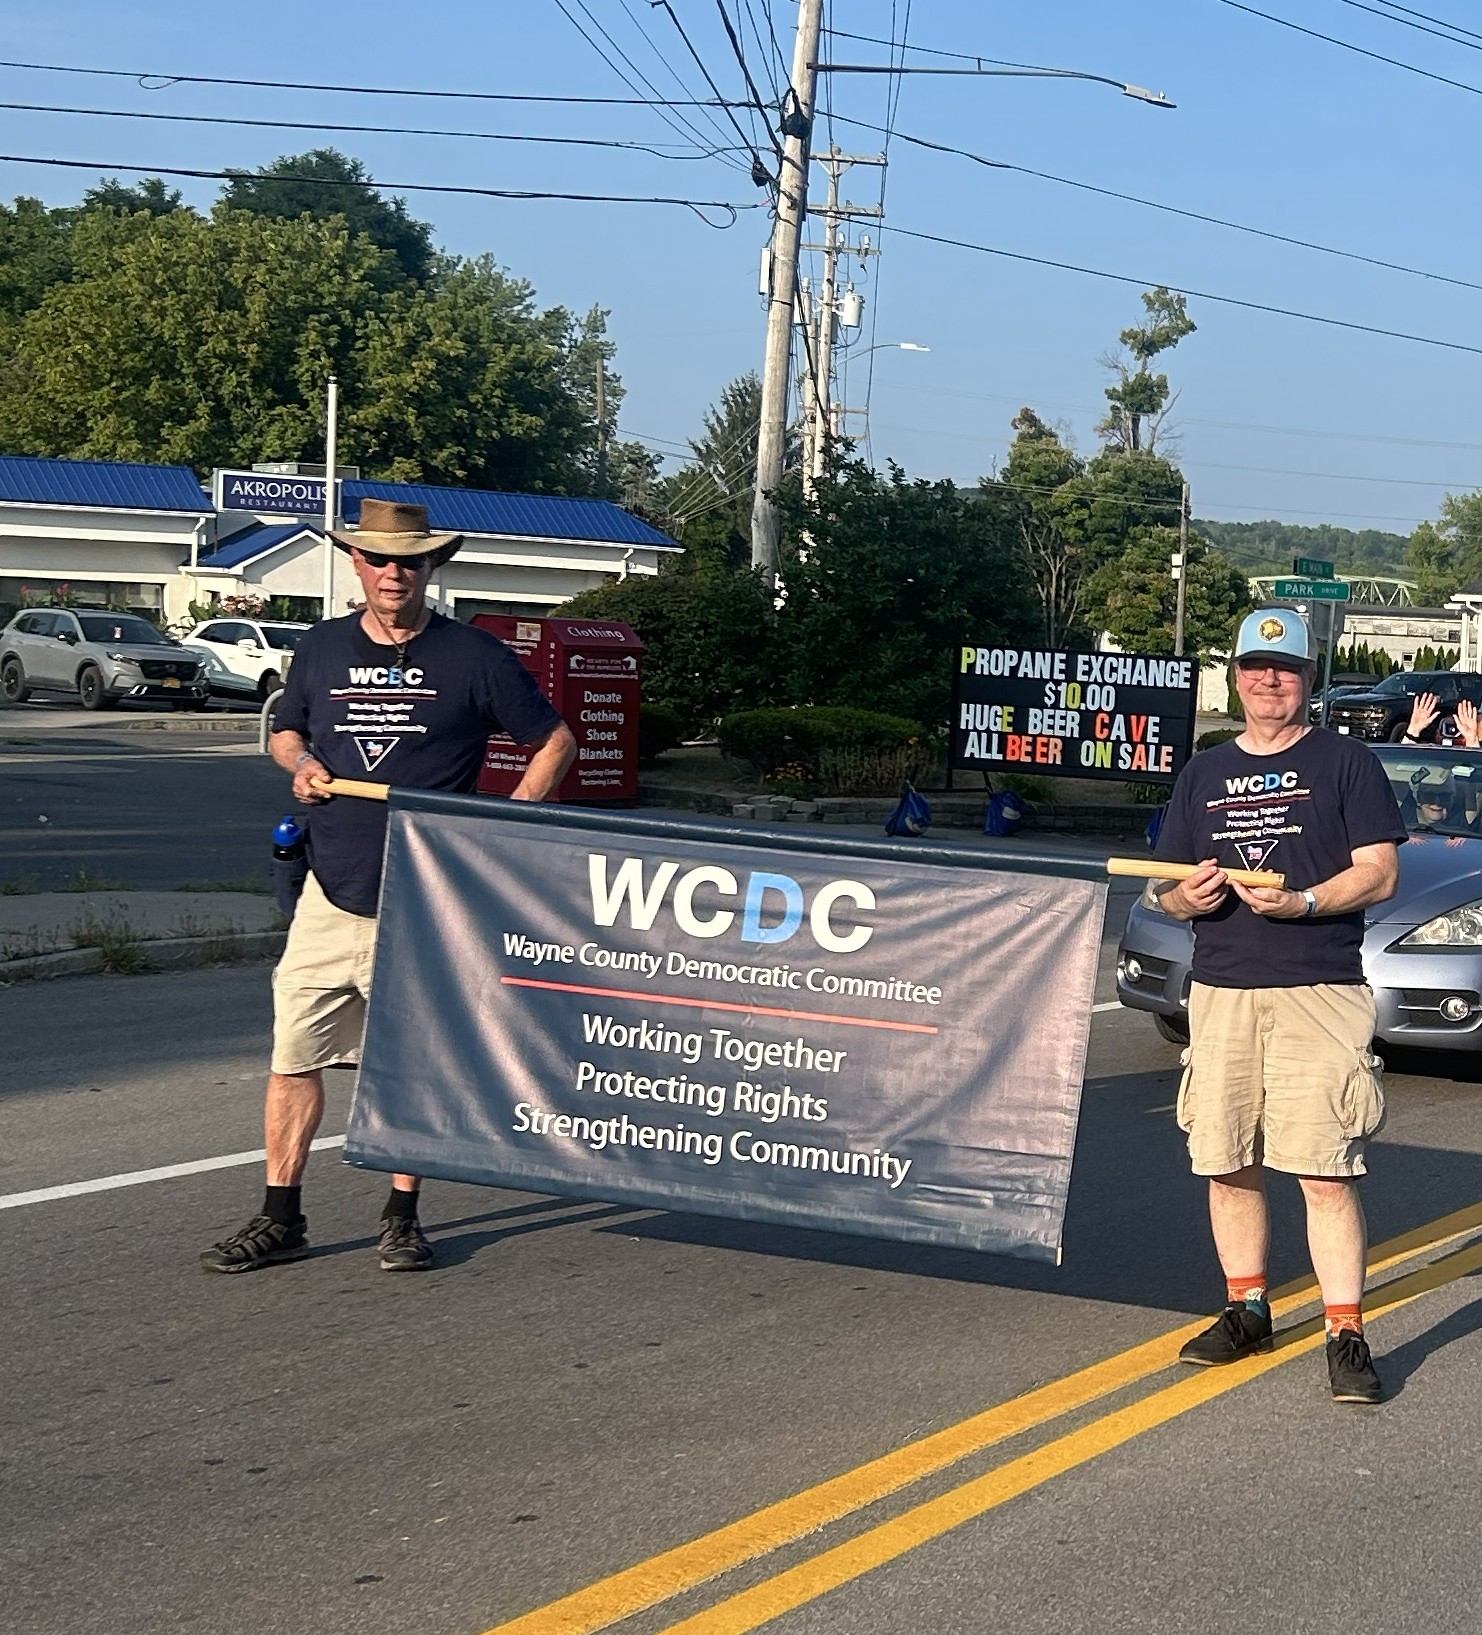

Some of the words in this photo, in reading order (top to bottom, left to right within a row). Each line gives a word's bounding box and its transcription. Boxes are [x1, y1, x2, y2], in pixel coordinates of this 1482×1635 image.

[240, 498, 318, 509] RESTAURANT
[1284, 583, 1314, 596] PARK
[567, 626, 625, 642] Clothing
[960, 647, 1067, 681] PROPANE
[1076, 654, 1192, 689] EXCHANGE
[583, 690, 622, 703] Donate
[1043, 681, 1116, 711] $10.00
[580, 709, 624, 725] Clothing
[959, 703, 1014, 733] HUGE
[1027, 707, 1080, 738] BEER
[1094, 712, 1160, 743] CAVE
[586, 729, 618, 741] Shoes
[579, 747, 624, 760] Blankets
[963, 731, 1003, 760] ALL
[1005, 734, 1063, 765] BEER
[1080, 740, 1113, 769] ON
[1118, 743, 1173, 773] SALE
[1225, 770, 1299, 795] WCDC
[588, 853, 876, 954] WCDC
[503, 931, 575, 966] Wayne
[579, 942, 663, 978] County
[665, 952, 803, 990] Democratic
[805, 967, 942, 1005] Committee
[581, 1013, 702, 1064] Working
[709, 1028, 847, 1073] Together
[575, 1061, 727, 1116] Protecting
[733, 1081, 829, 1123] Rights
[512, 1102, 724, 1165] Strengthening
[729, 1130, 912, 1189] Community
